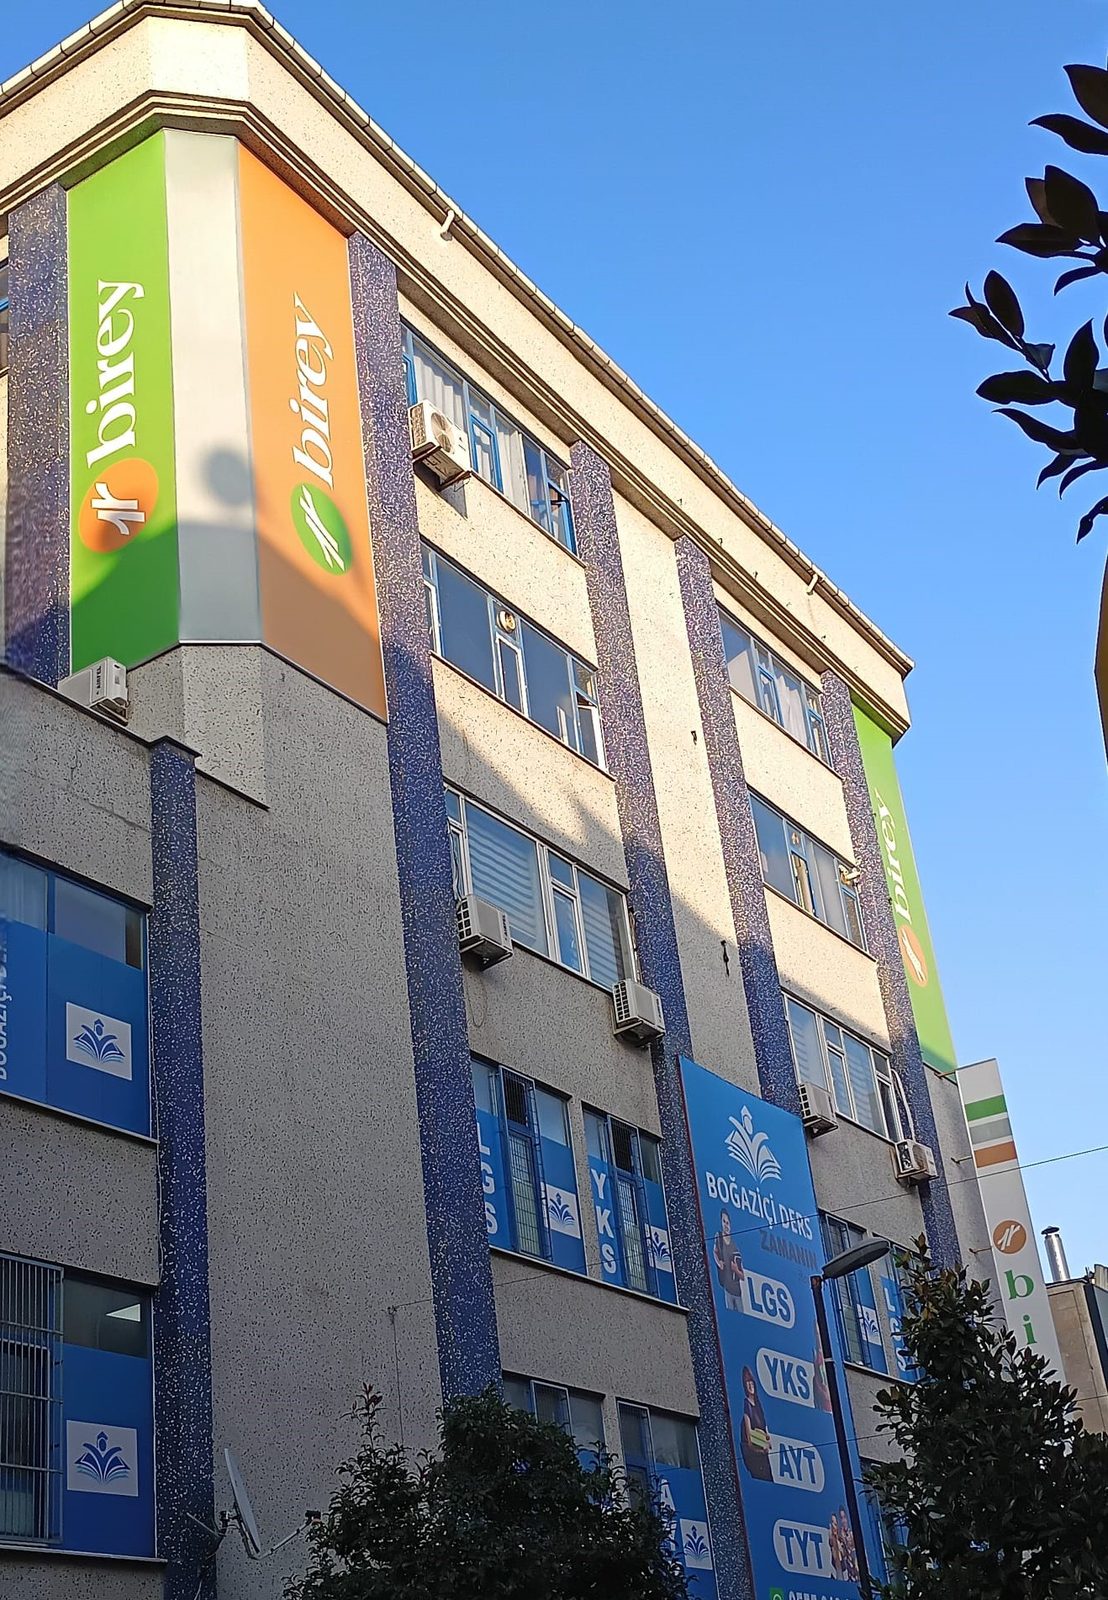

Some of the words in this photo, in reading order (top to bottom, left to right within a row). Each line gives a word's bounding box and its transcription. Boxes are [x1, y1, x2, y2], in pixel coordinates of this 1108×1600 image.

[86, 279, 146, 469] birey
[289, 292, 335, 489] birey
[875, 788, 912, 924] birey
[591, 1169, 616, 1273] YKS
[705, 1171, 778, 1230] BOĞAZİÇİ
[778, 1203, 813, 1241] DERS
[749, 1276, 791, 1322] LGS
[763, 1354, 811, 1400] YKS
[778, 1442, 817, 1485] AYT
[779, 1526, 824, 1570] TYT
